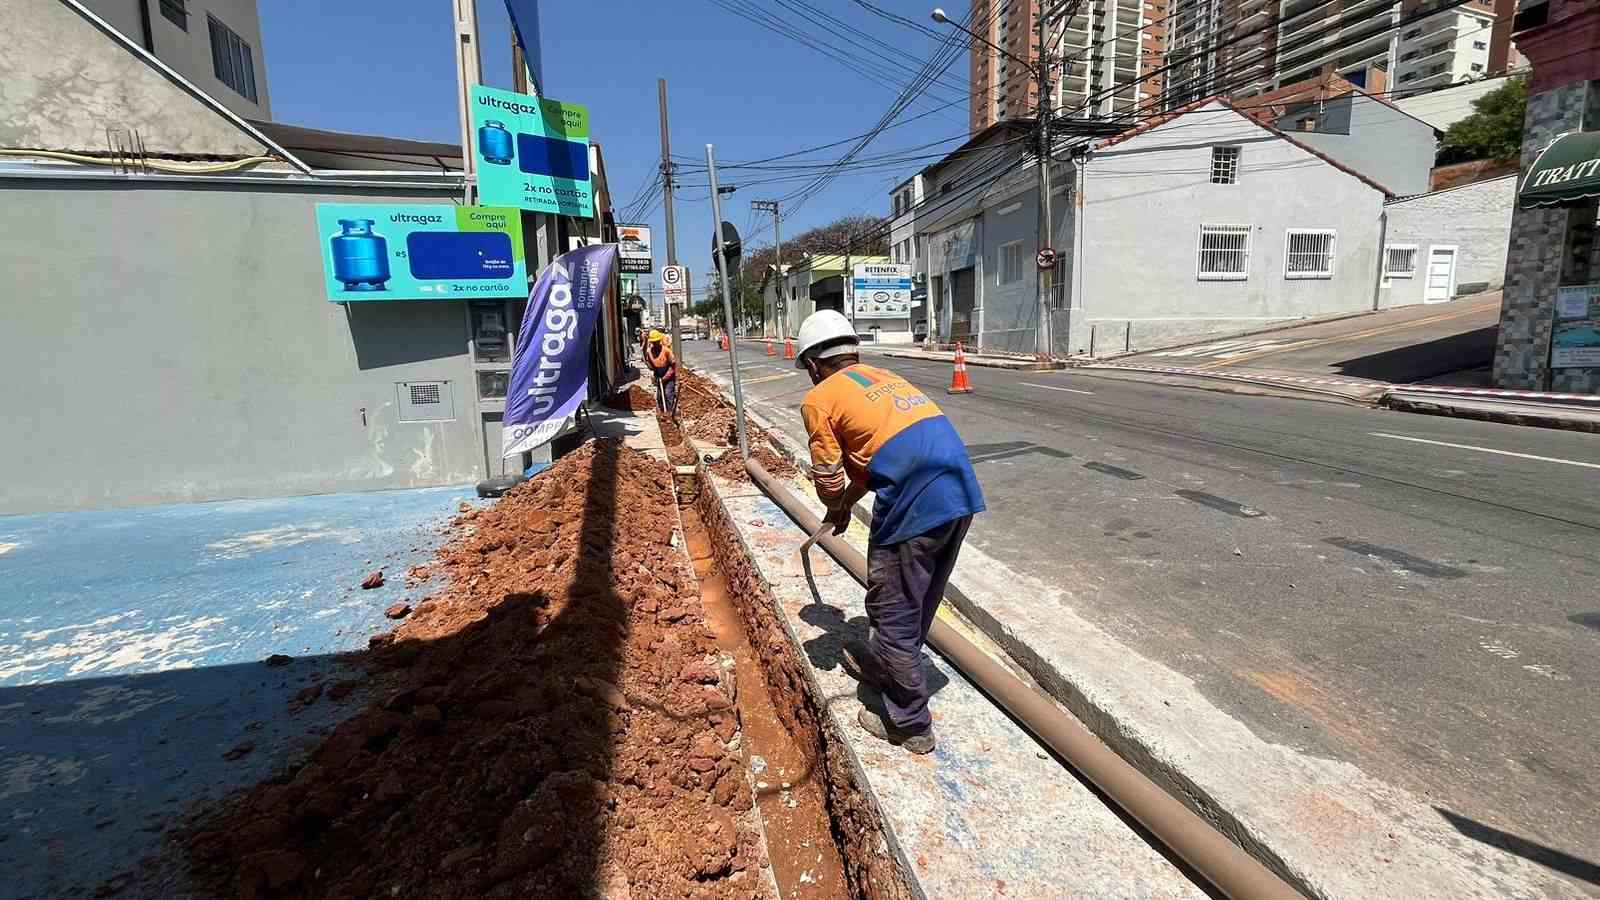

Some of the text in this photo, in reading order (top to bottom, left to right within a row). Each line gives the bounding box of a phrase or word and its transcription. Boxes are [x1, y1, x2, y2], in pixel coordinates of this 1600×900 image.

[478, 95, 537, 115] ultragaz
[560, 119, 582, 129] aqui!
[524, 182, 588, 199] 2x no cartão
[390, 212, 443, 226] ultragaz
[469, 212, 506, 223] Compre
[667, 270, 675, 281] E
[453, 282, 510, 293] 2x no cartão
[577, 258, 592, 309] somando
[586, 261, 600, 309] energias
